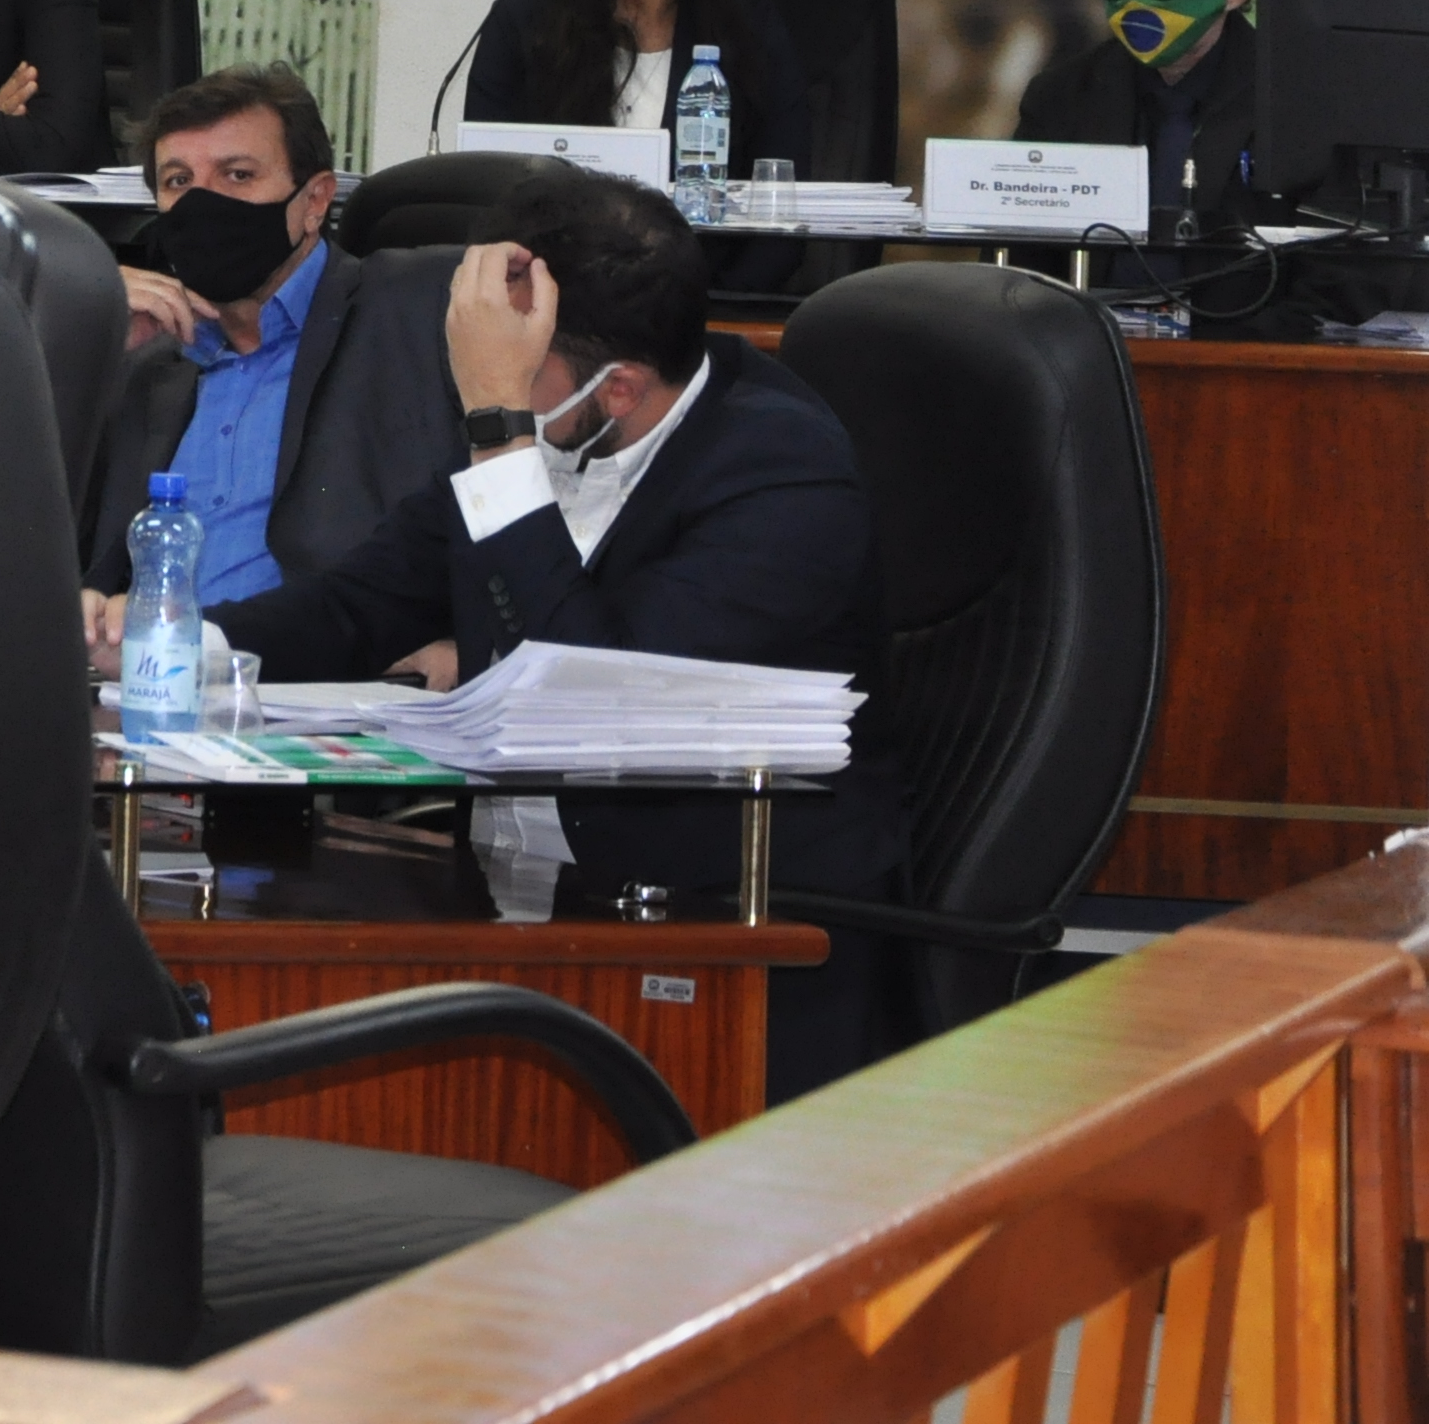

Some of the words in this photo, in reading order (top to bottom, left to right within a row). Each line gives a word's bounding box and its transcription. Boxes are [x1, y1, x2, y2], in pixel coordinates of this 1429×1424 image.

[970, 180, 989, 191] Dr.
[994, 181, 1058, 195] Bandeira
[1071, 185, 1101, 196] PDT
